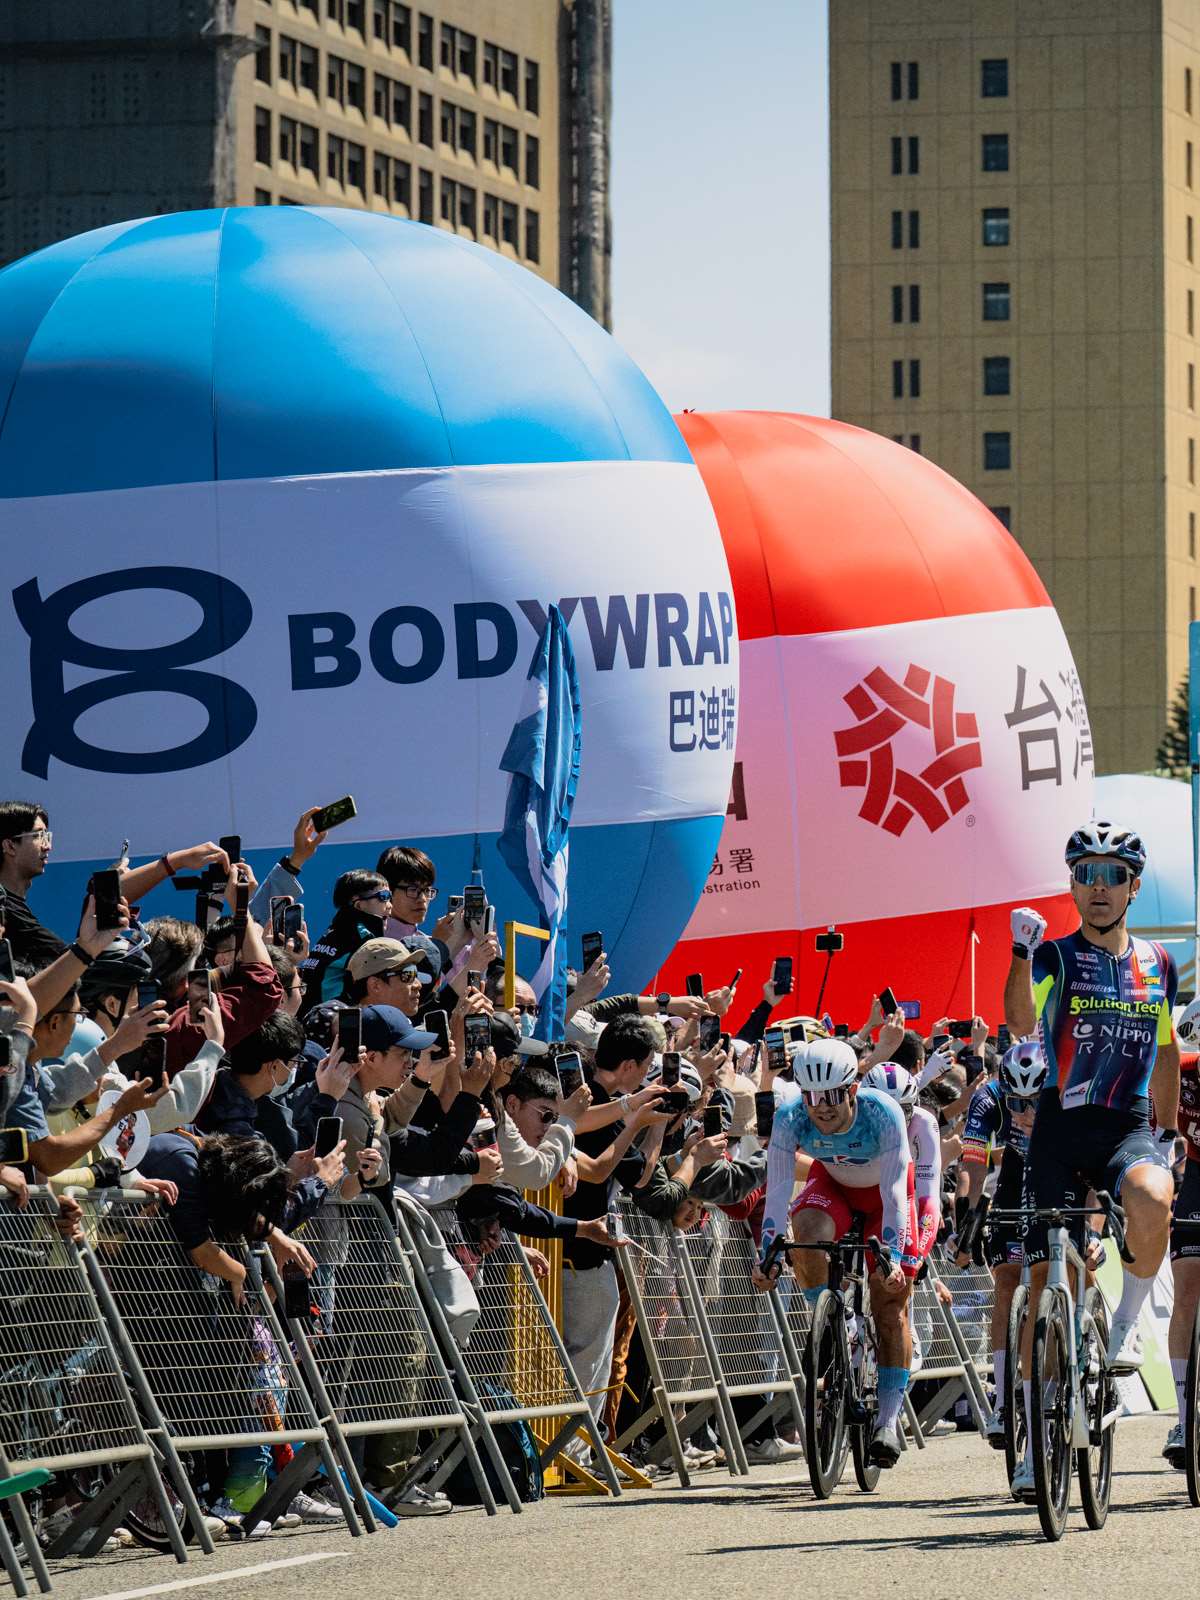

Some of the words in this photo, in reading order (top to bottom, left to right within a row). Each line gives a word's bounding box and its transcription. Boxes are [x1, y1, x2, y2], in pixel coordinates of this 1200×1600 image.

[288, 591, 734, 691] BODYWRAP
[1069, 995, 1131, 1015] Solution
[1134, 1000, 1161, 1015] Tech
[1100, 1024, 1152, 1044] NIPPO
